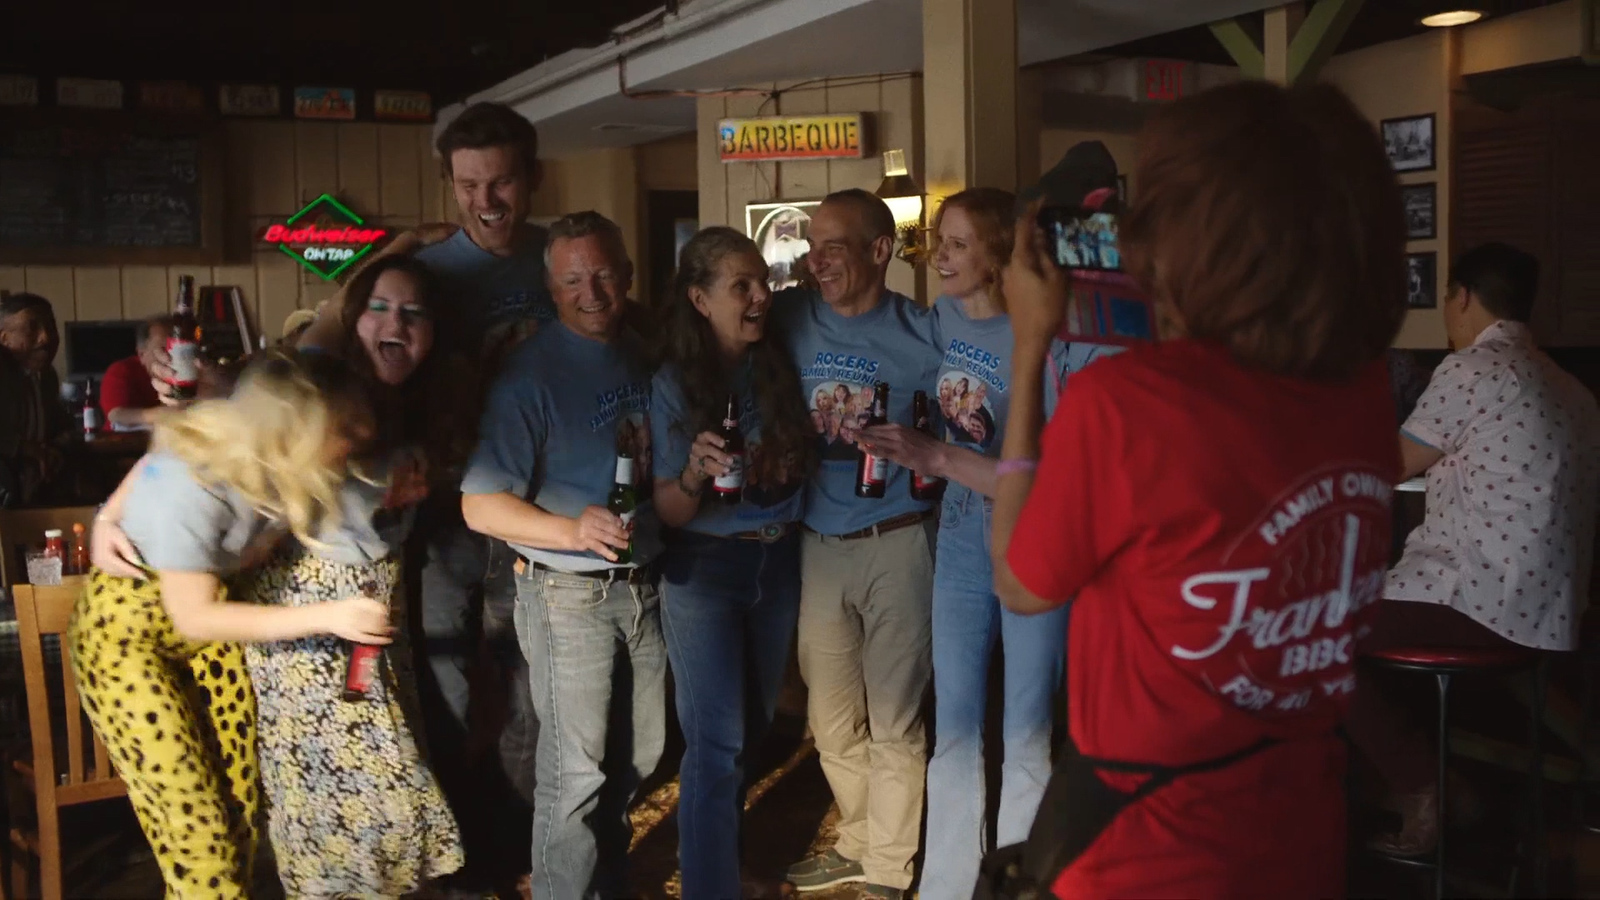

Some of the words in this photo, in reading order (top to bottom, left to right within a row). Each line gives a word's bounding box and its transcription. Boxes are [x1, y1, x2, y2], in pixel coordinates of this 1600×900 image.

[1146, 60, 1186, 100] EXIT
[721, 121, 857, 154] BARBEQUE
[265, 224, 386, 243] Budweiser
[814, 352, 879, 375] ROGERS
[948, 337, 1001, 371] ROGERS
[836, 369, 883, 387] REUNI
[965, 361, 1008, 393] REUNION
[1259, 476, 1334, 546] FAMILY
[1219, 675, 1275, 711] FOR
